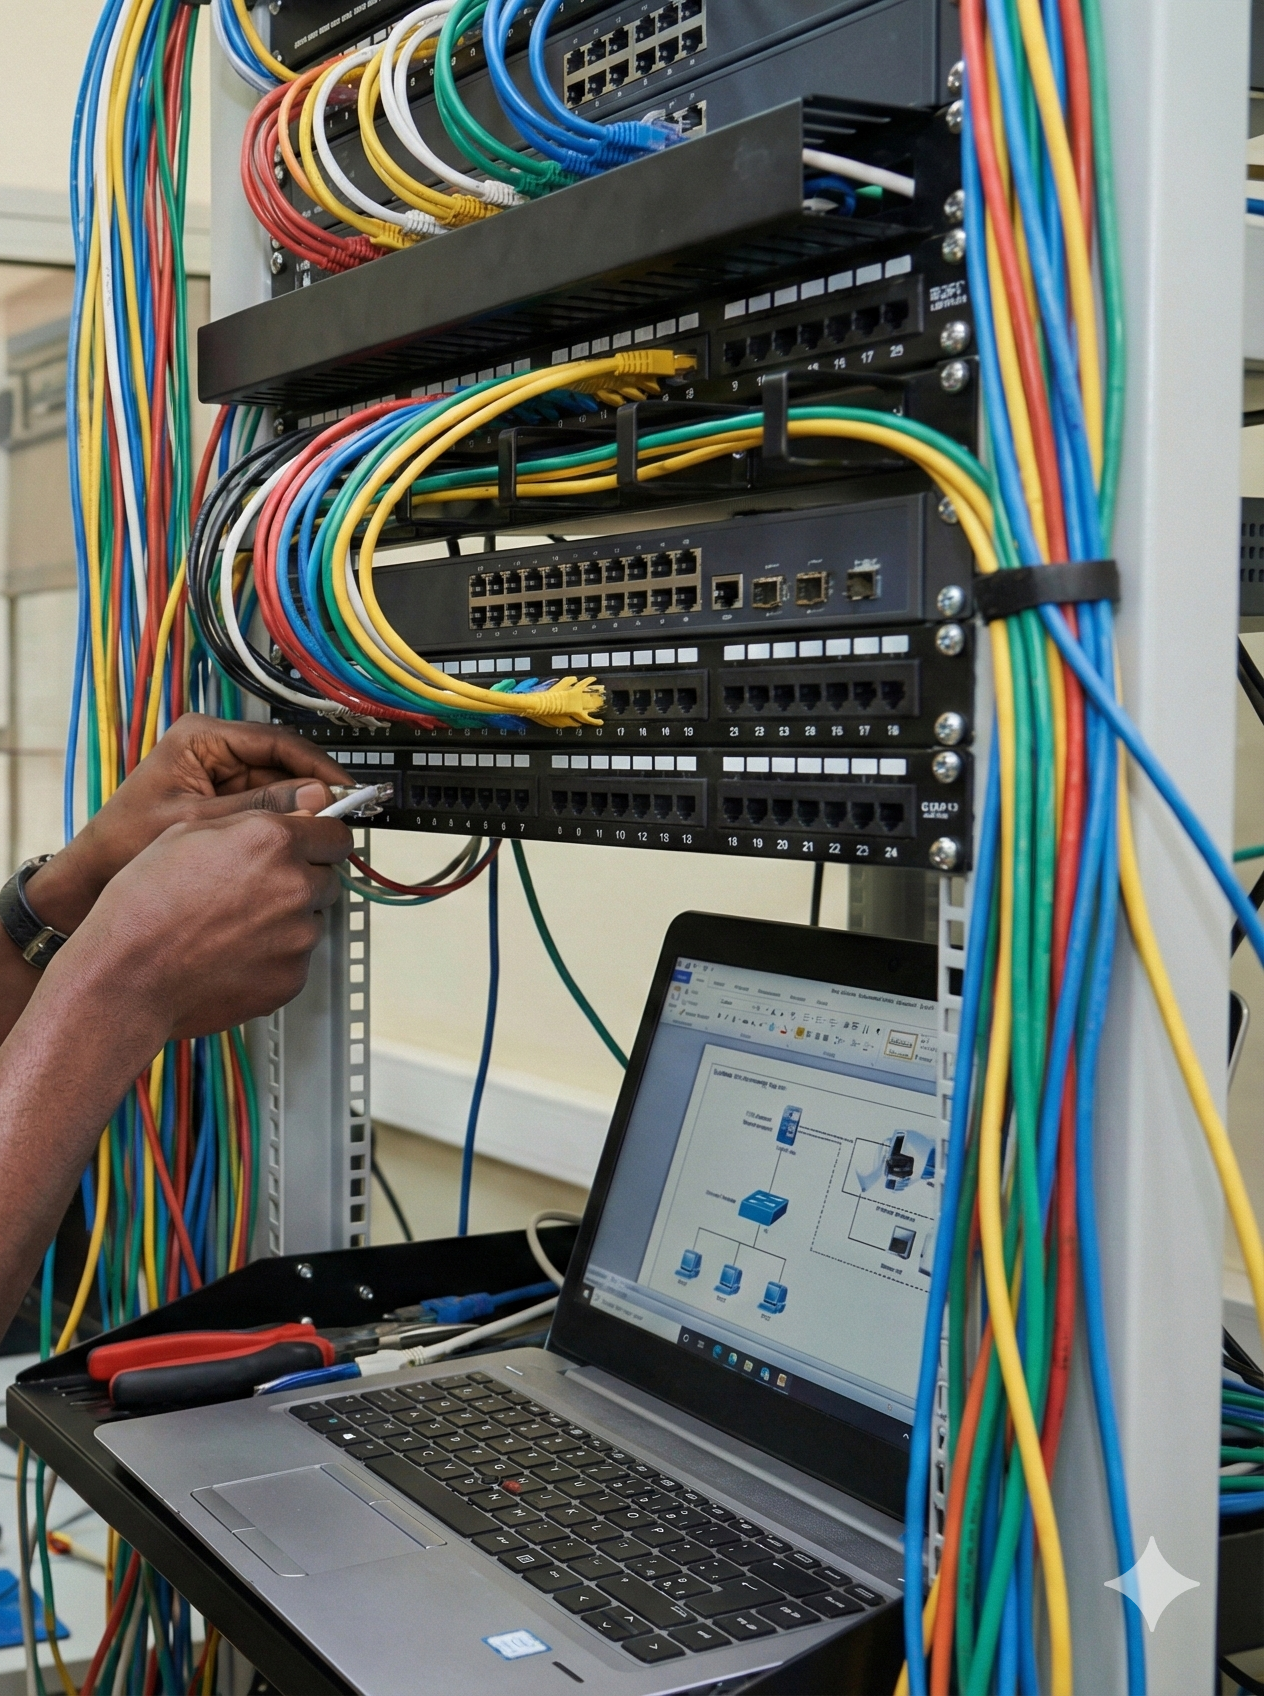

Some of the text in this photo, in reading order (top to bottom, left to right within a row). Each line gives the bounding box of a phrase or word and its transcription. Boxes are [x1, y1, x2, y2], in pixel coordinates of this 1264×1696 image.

[860, 350, 874, 364] 17
[615, 830, 626, 840] 10
[637, 831, 648, 842] 12
[727, 836, 738, 847] 18
[752, 838, 763, 848] 19
[776, 839, 788, 850] 20
[802, 841, 814, 852] 21
[828, 843, 841, 854] 22
